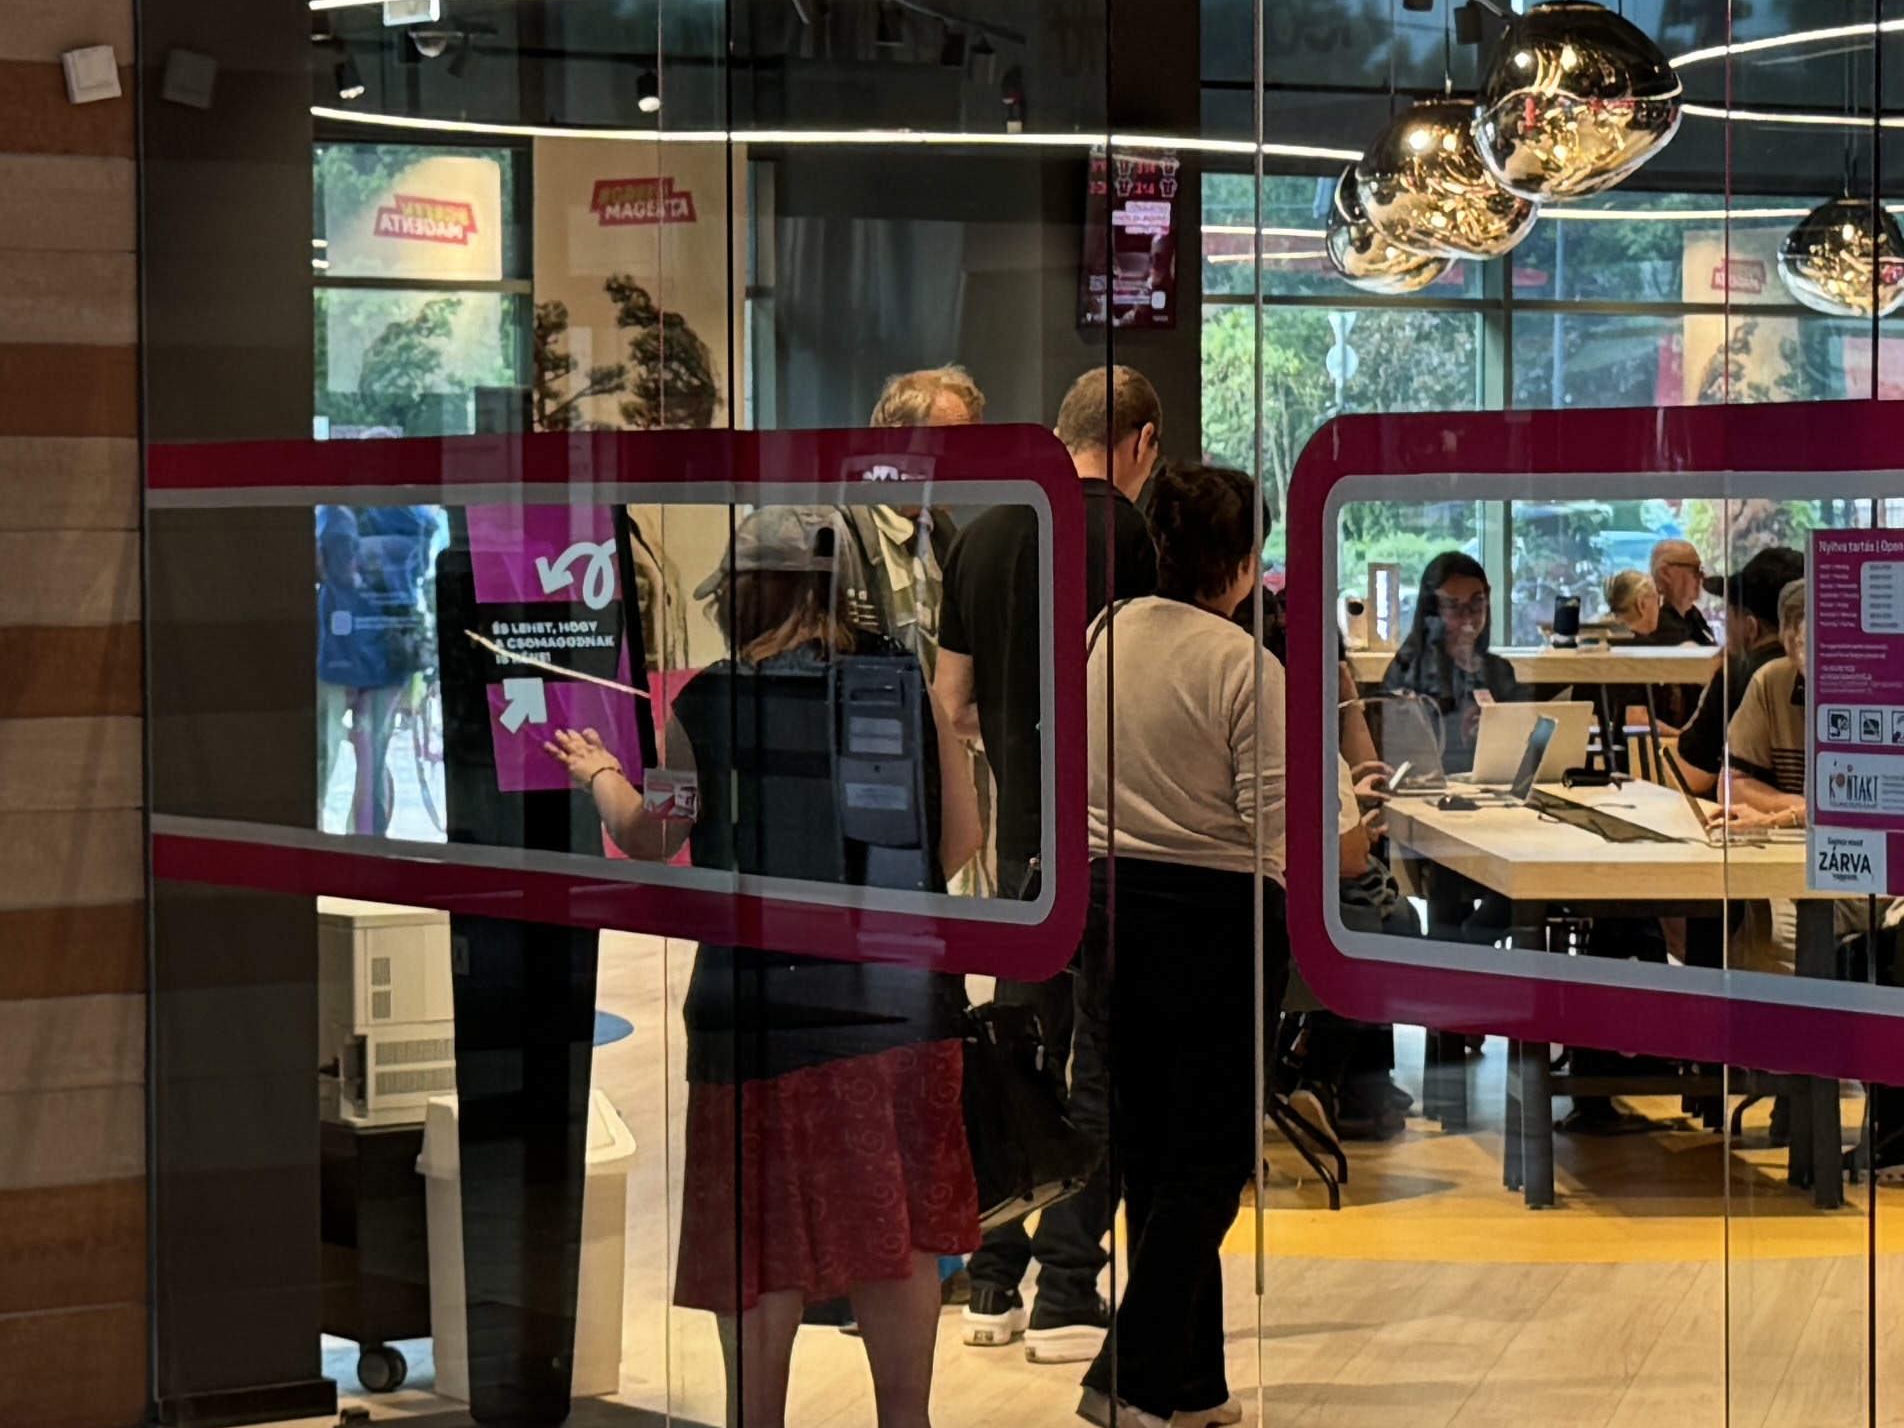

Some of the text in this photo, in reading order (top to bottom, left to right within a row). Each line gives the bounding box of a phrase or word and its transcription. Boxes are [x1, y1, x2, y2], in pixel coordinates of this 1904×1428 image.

[1880, 539, 1904, 554] Open
[558, 621, 598, 634] HOGY
[1819, 845, 1872, 874] ZÁRVA
